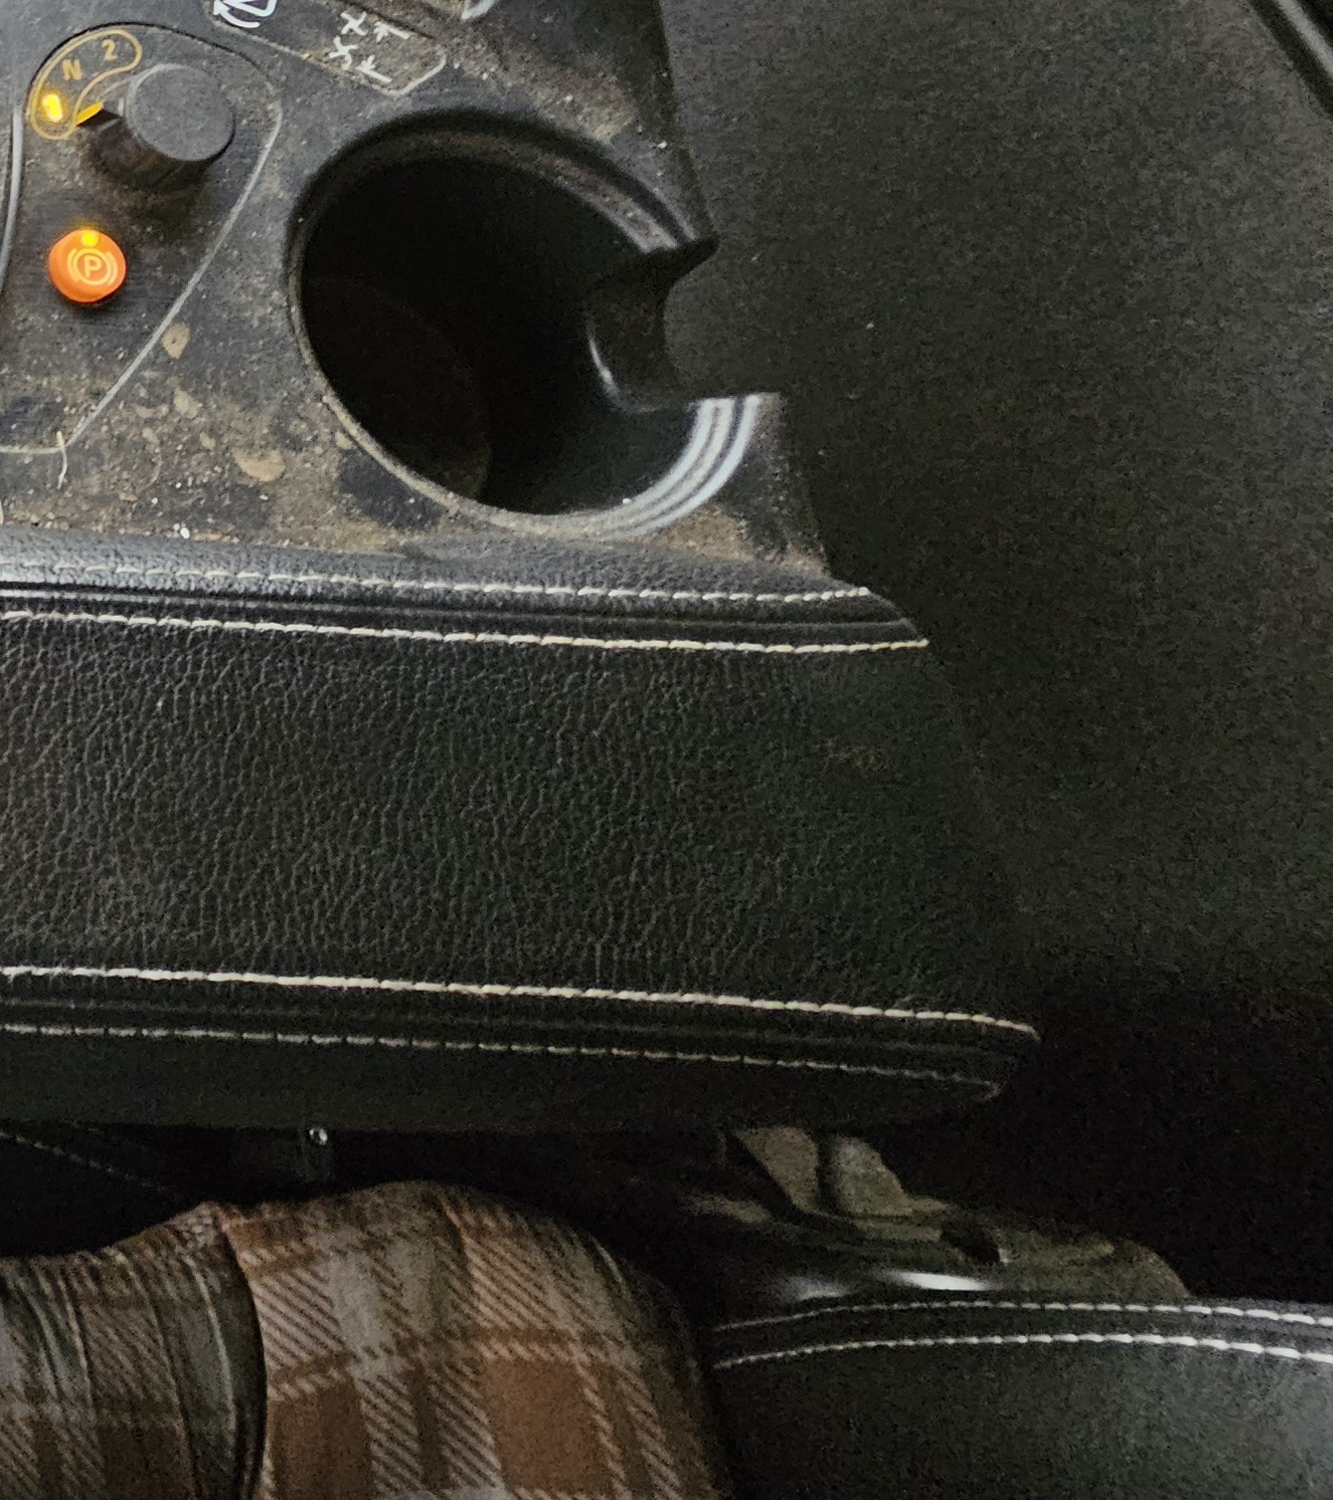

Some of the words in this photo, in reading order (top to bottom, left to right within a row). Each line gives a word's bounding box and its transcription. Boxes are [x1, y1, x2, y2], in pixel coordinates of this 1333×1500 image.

[101, 39, 118, 61] 2
[62, 59, 83, 81] N
[42, 93, 63, 122] 1
[84, 255, 102, 278] P
